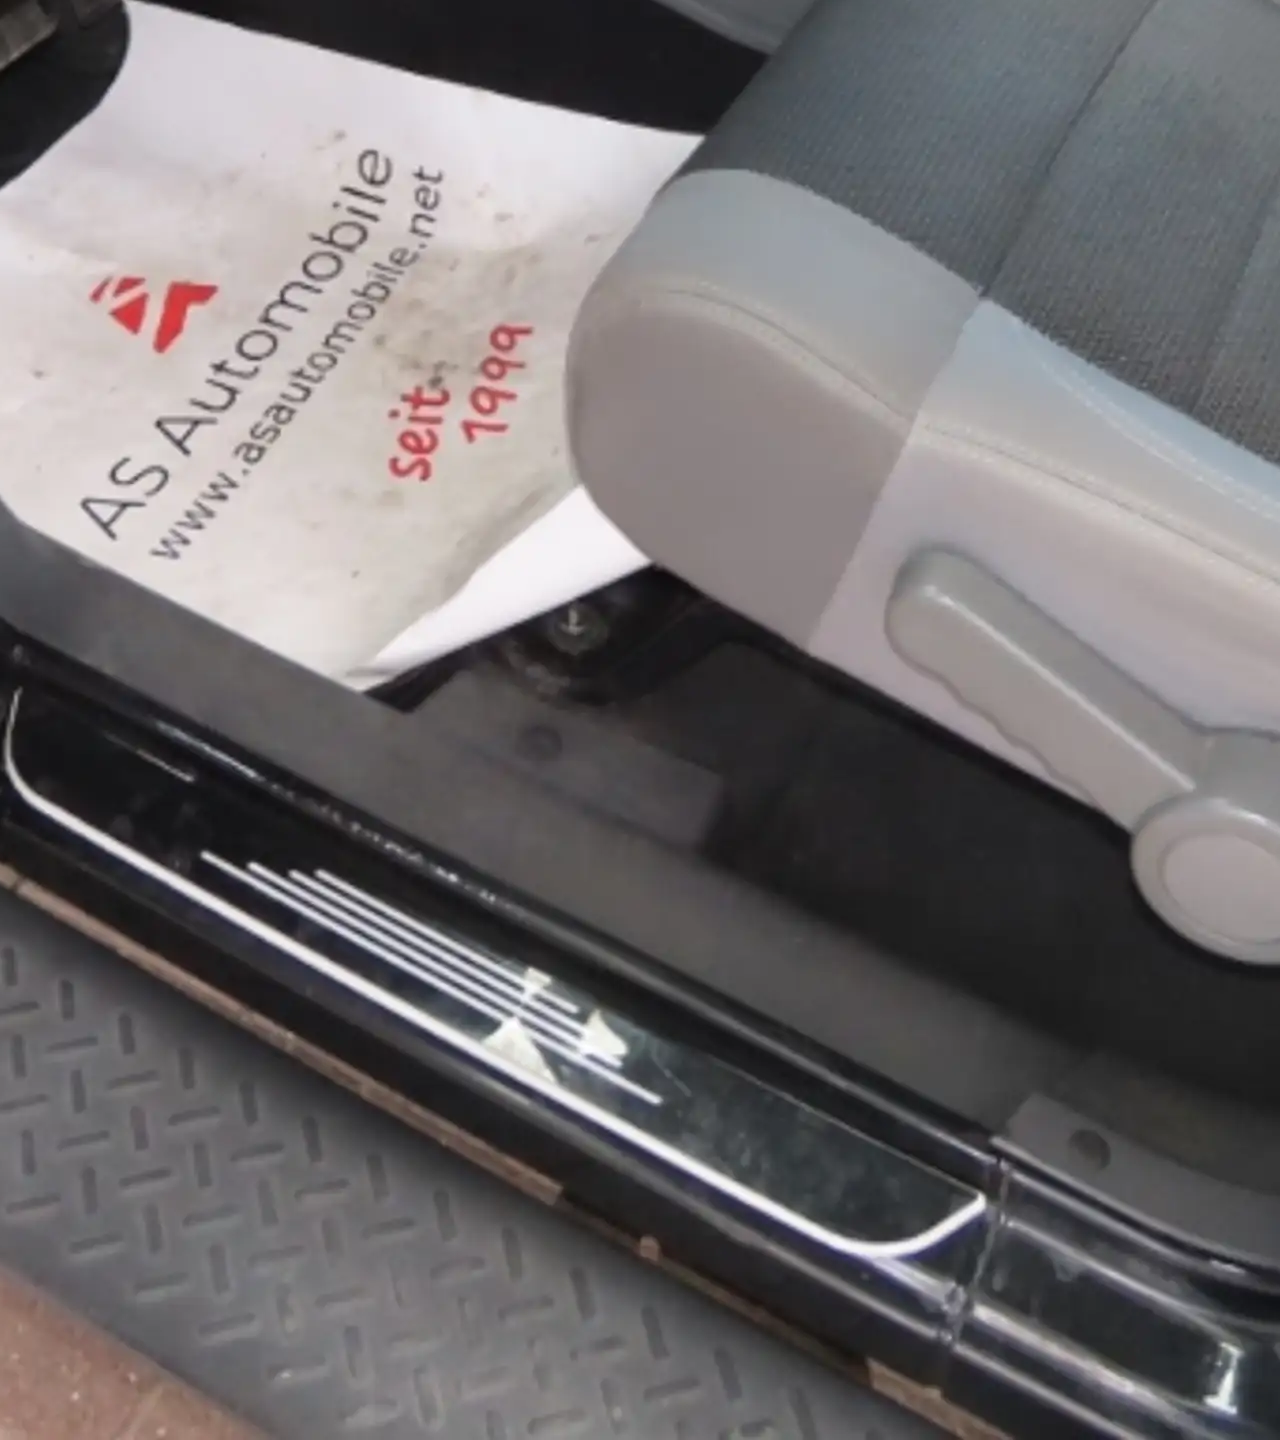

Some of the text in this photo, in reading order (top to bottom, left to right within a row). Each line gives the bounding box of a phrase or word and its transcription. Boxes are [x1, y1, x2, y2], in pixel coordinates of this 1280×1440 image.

[80, 148, 393, 541] AS Automobile
[150, 166, 444, 561] www.asautomobile.net
[389, 386, 452, 482] seit
[462, 324, 533, 444] 1999
